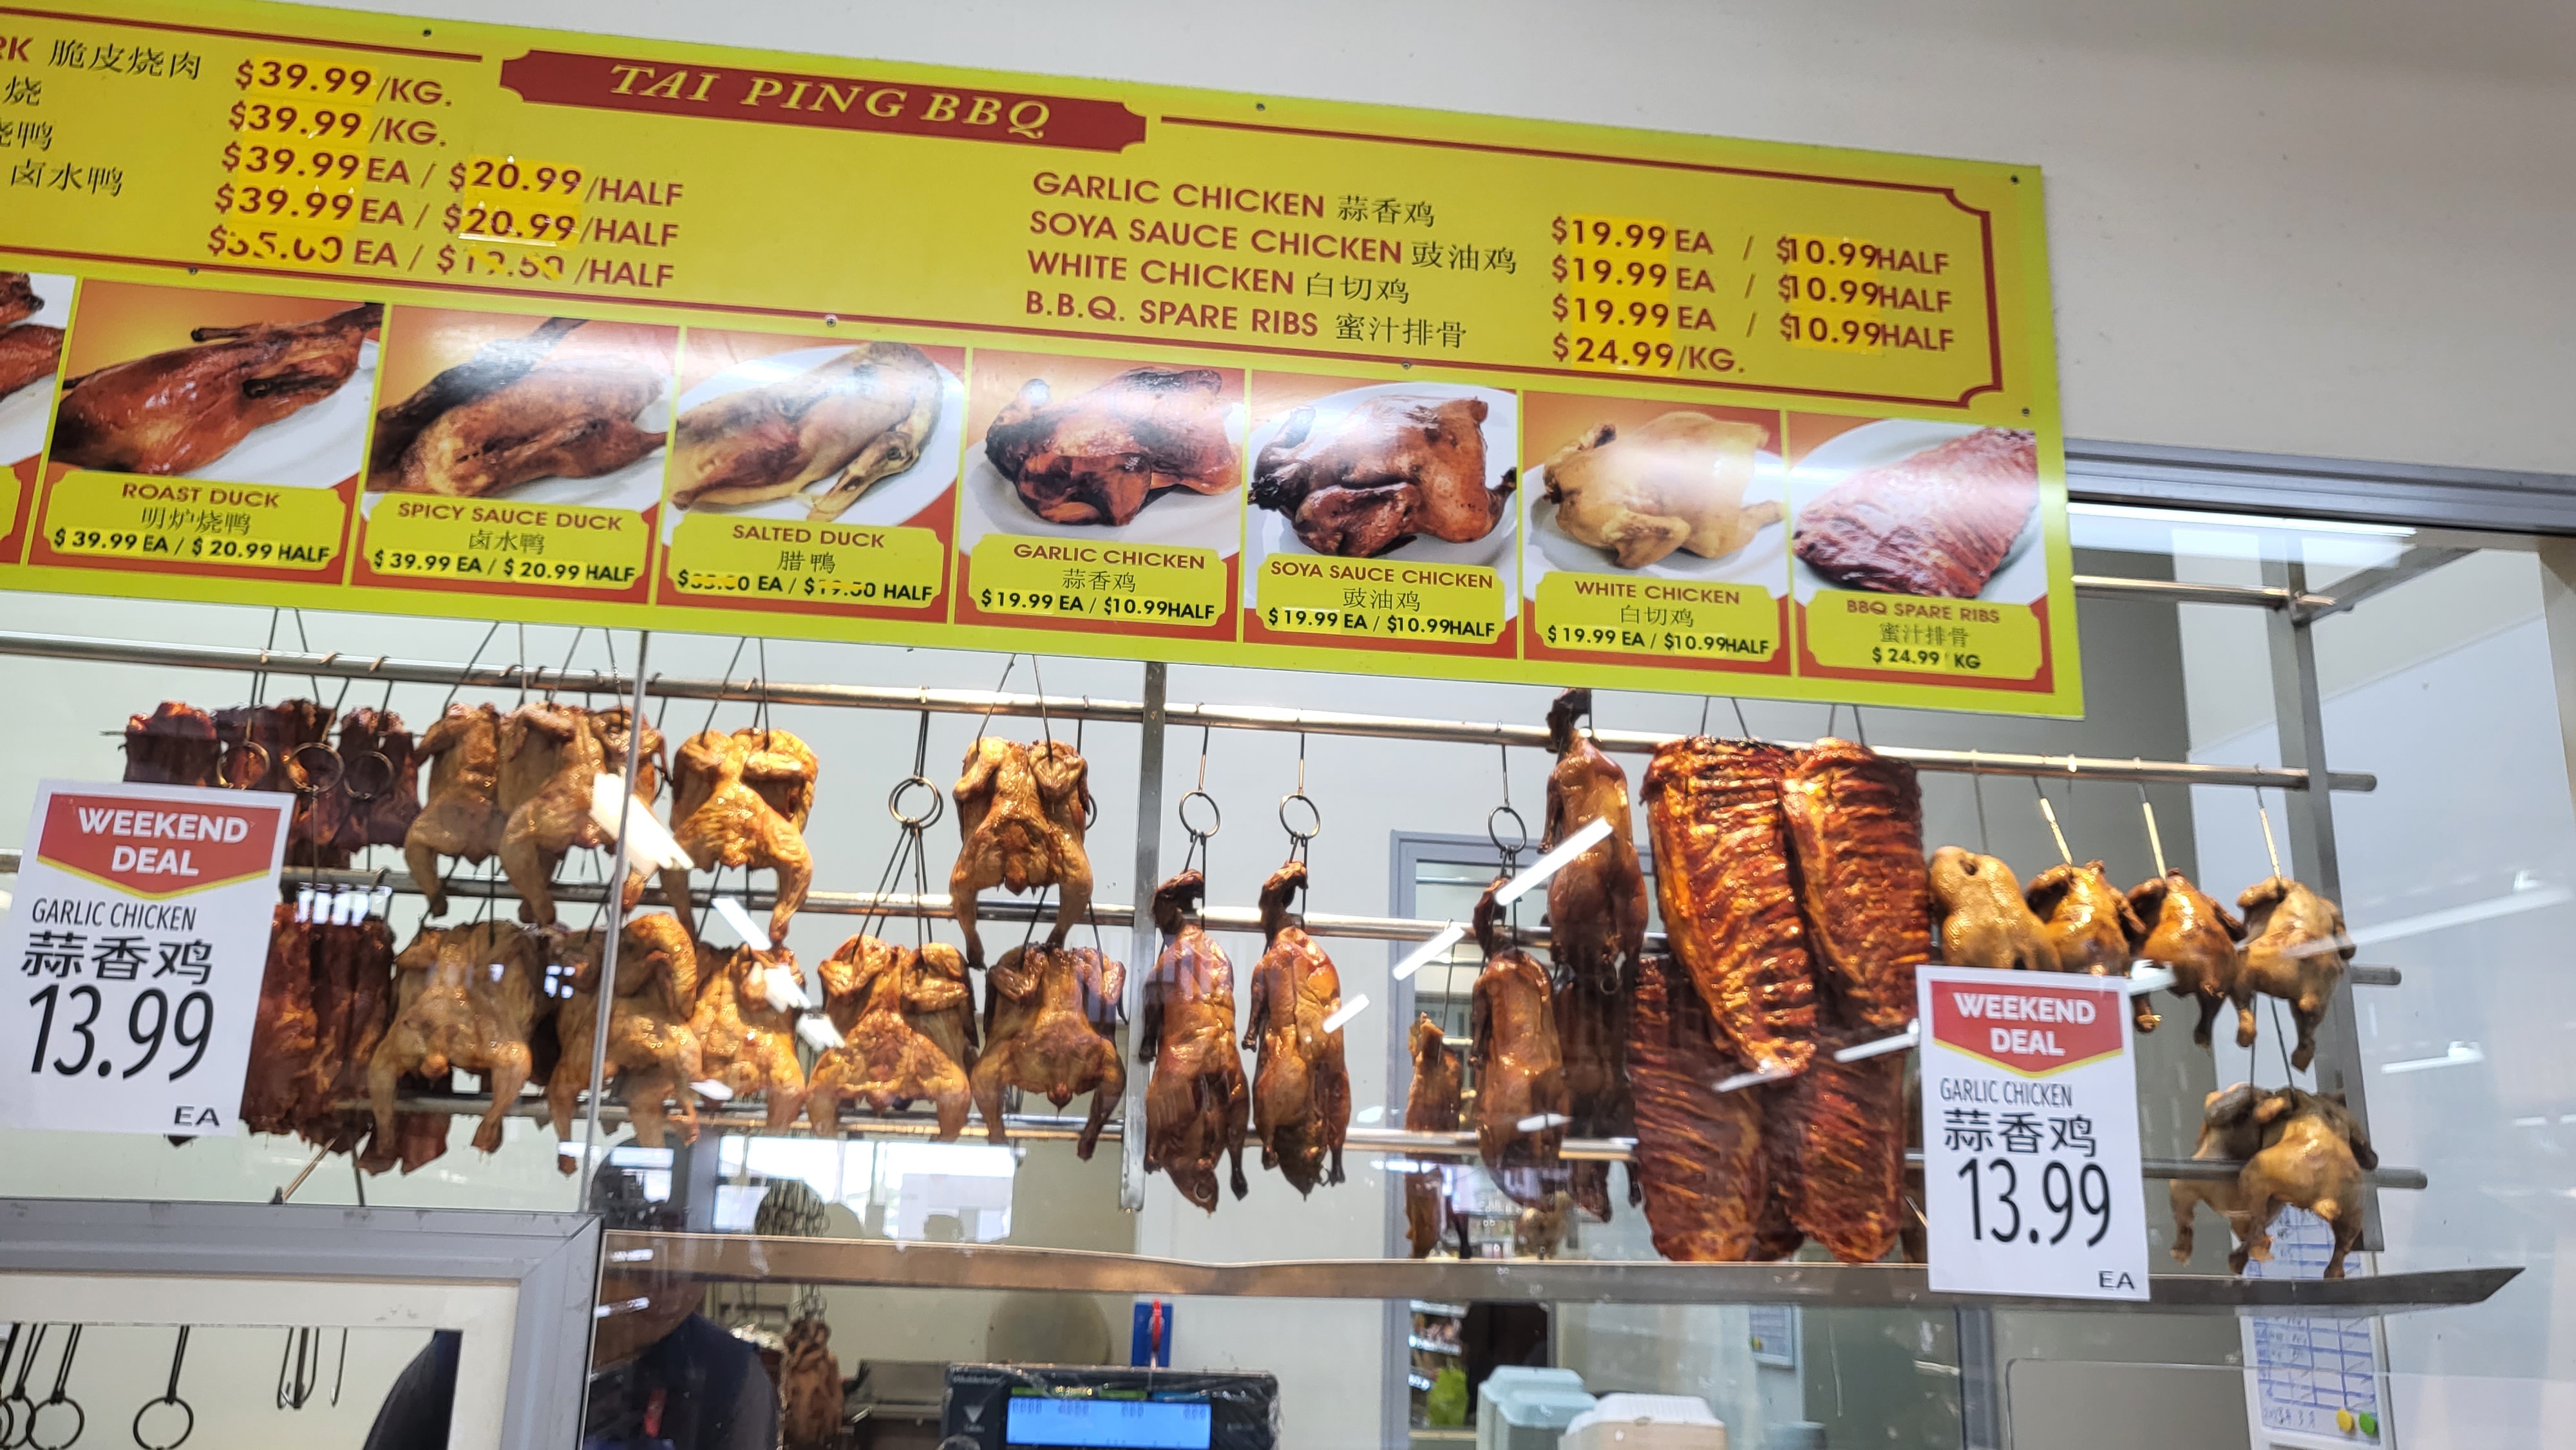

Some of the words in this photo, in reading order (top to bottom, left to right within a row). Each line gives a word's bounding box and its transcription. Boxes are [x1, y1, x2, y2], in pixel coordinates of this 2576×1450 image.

[48, 39, 202, 80] 脆皮烧肉
[610, 64, 720, 102] TAI
[739, 77, 908, 118] PING
[920, 93, 1051, 140] BBQ
[11, 158, 124, 197] 卤水鸭
[1033, 171, 1160, 204] GARLIC
[1172, 184, 1325, 219] CHICKEN
[1337, 194, 1435, 228] 蒜香鸡
[1030, 211, 1117, 241] SOYA
[1128, 218, 1238, 250] SAUCE
[1251, 229, 1402, 264] CHICKEN
[1676, 229, 1715, 255] EA
[1742, 234, 1755, 261] /
[354, 240, 399, 268] EA
[1410, 240, 1517, 275] 豉油鸡
[1027, 249, 1127, 281] WHITE
[1140, 259, 1294, 296] CHICKEN
[1307, 272, 1410, 305] 白切鸡
[1676, 267, 1716, 294] EA
[1744, 272, 1757, 299] /
[1026, 290, 1125, 321] B.B.Q.
[1139, 300, 1238, 332] SPARE
[1251, 308, 1318, 337] RIBS
[1677, 305, 1717, 332] EA
[1745, 311, 1757, 338] /
[1335, 312, 1468, 349] 蜜汁排骨
[122, 482, 202, 504] ROAST
[209, 487, 281, 509] DUCK
[398, 501, 466, 521] SPICY
[471, 507, 548, 527] SAUCE
[555, 512, 623, 531] DUCK
[143, 535, 169, 554] EA
[278, 544, 330, 563] HALF
[732, 524, 811, 543] SALTED
[820, 529, 886, 549] DUCK
[457, 558, 482, 573] EA
[585, 565, 636, 583] HALF
[1014, 543, 1097, 563] GARLIC
[1103, 549, 1206, 570] CHICKEN
[757, 576, 783, 592] EA
[883, 583, 933, 602] HALF
[1061, 567, 1137, 593] 蒜香鸡
[1270, 560, 1324, 578] SOYA
[1329, 565, 1395, 583] SAUCE
[1401, 569, 1493, 589] CHICKEN
[1059, 595, 1084, 612] EA
[1343, 587, 1421, 612] 豉油鸡
[1574, 581, 1637, 599] WHITE
[1643, 585, 1740, 605] CHICKEN
[1343, 613, 1368, 630] EA
[1620, 604, 1694, 628] 白切鸡
[1846, 599, 1888, 616] BBQ
[1893, 603, 1952, 620] SPARE
[1959, 607, 2000, 624] RIBS
[1622, 630, 1646, 647] EA
[1953, 652, 1982, 670] KG
[78, 806, 249, 843] WEEKEND
[110, 845, 200, 877] DEAL
[31, 898, 106, 927] GARLIC
[109, 902, 197, 932] CHICKEN
[21, 930, 213, 986] 蒜香鸡
[1953, 992, 2097, 1024] WEEKEND
[28, 983, 214, 1082] 13.99
[1990, 1026, 2066, 1057] DEAL
[1940, 1077, 2000, 1106] GARLIC
[2003, 1080, 2073, 1109] CHICKEN
[173, 1106, 221, 1127] EA
[1943, 1107, 2097, 1158] 蒜香鸡
[1957, 1157, 2111, 1248] 13.99
[2098, 1270, 2137, 1291] EA
